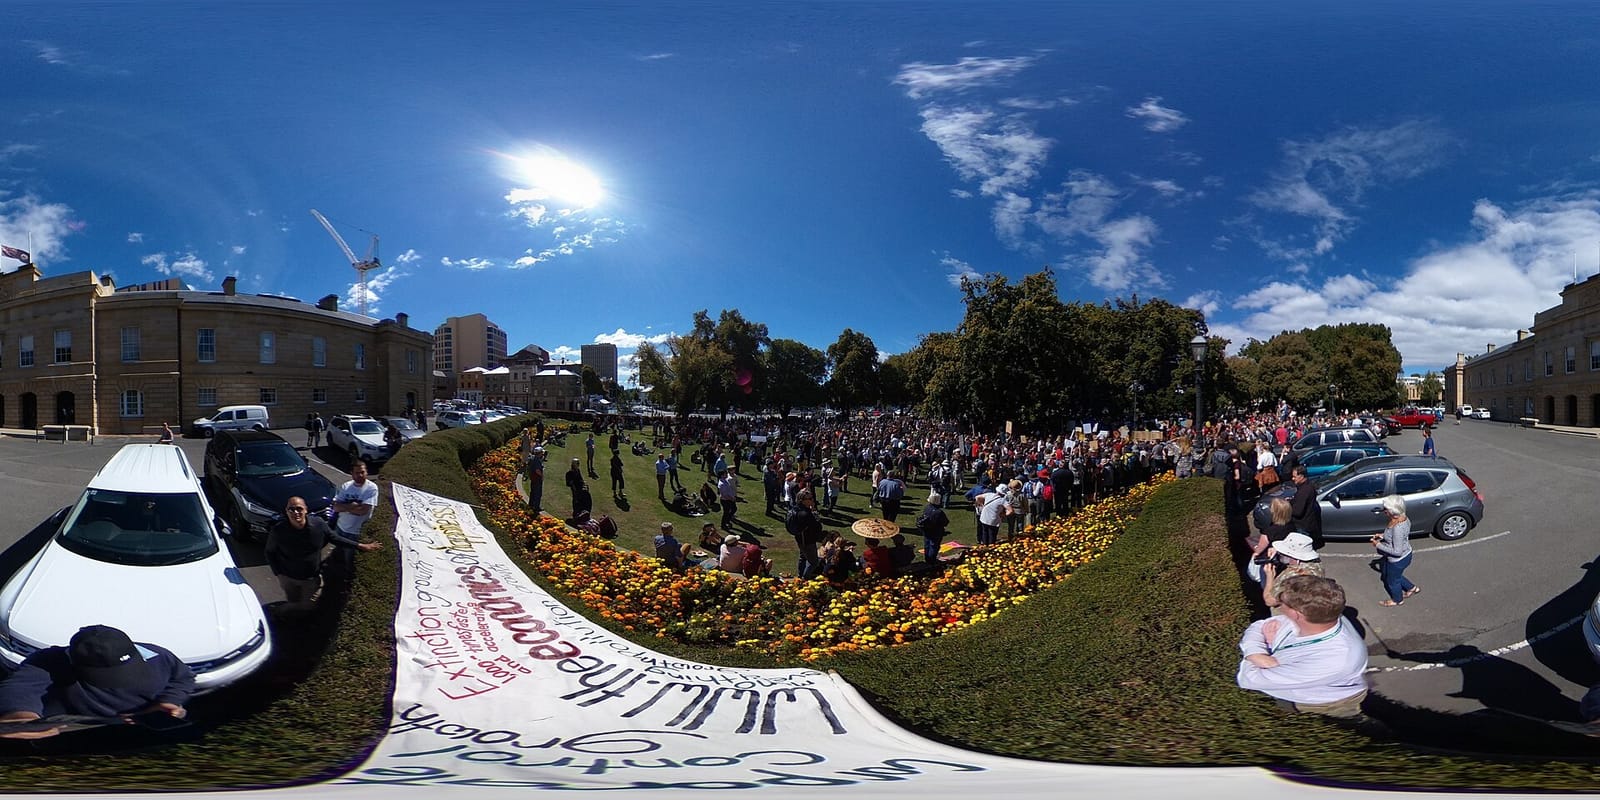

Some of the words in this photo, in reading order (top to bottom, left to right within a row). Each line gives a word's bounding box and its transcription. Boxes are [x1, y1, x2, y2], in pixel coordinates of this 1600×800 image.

[405, 606, 501, 700] Extinction
[494, 654, 532, 674] and
[387, 703, 709, 755] growth
